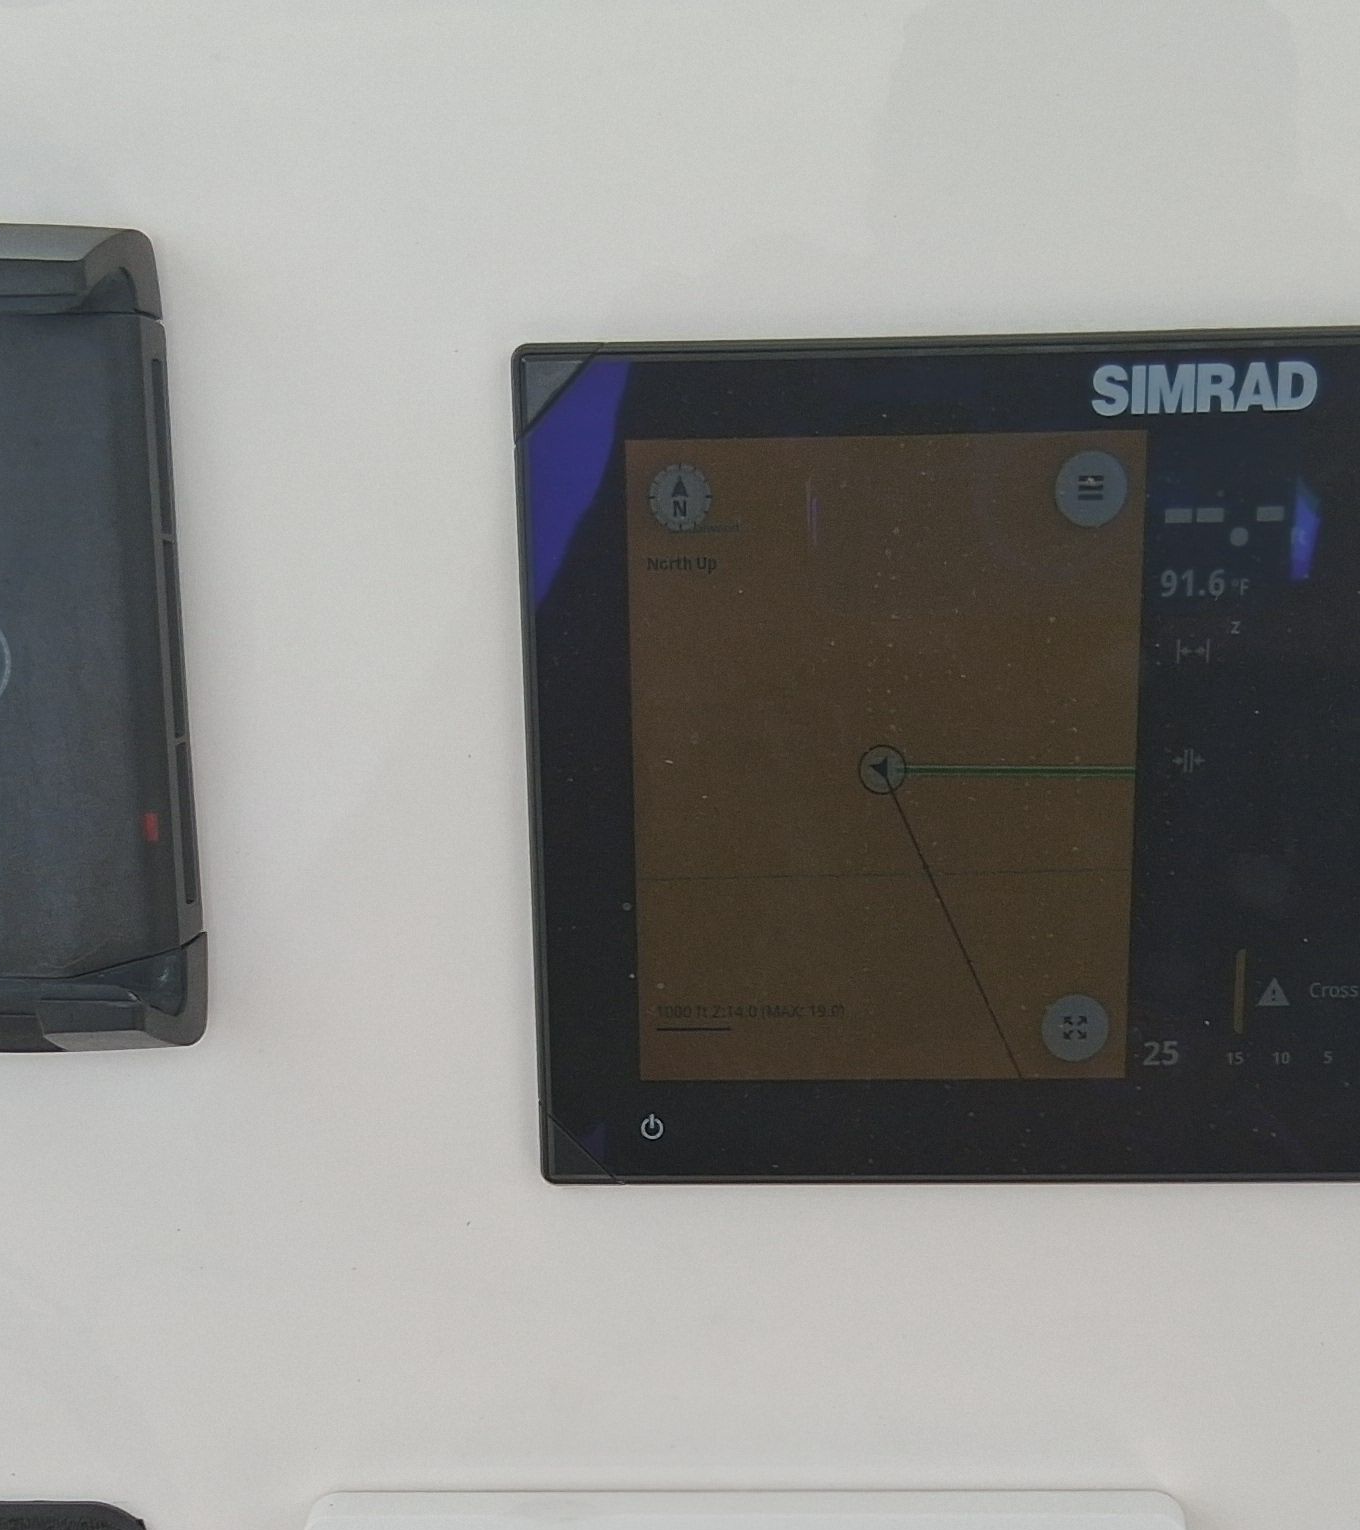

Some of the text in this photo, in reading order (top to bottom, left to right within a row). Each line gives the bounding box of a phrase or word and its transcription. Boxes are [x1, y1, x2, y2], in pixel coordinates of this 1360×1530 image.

[1092, 361, 1318, 416] SIMRAD
[673, 500, 687, 518] N
[647, 556, 718, 575] North Up
[1159, 568, 1226, 598] 91.6
[1309, 982, 1359, 998] Cross
[1142, 1041, 1180, 1067] 25
